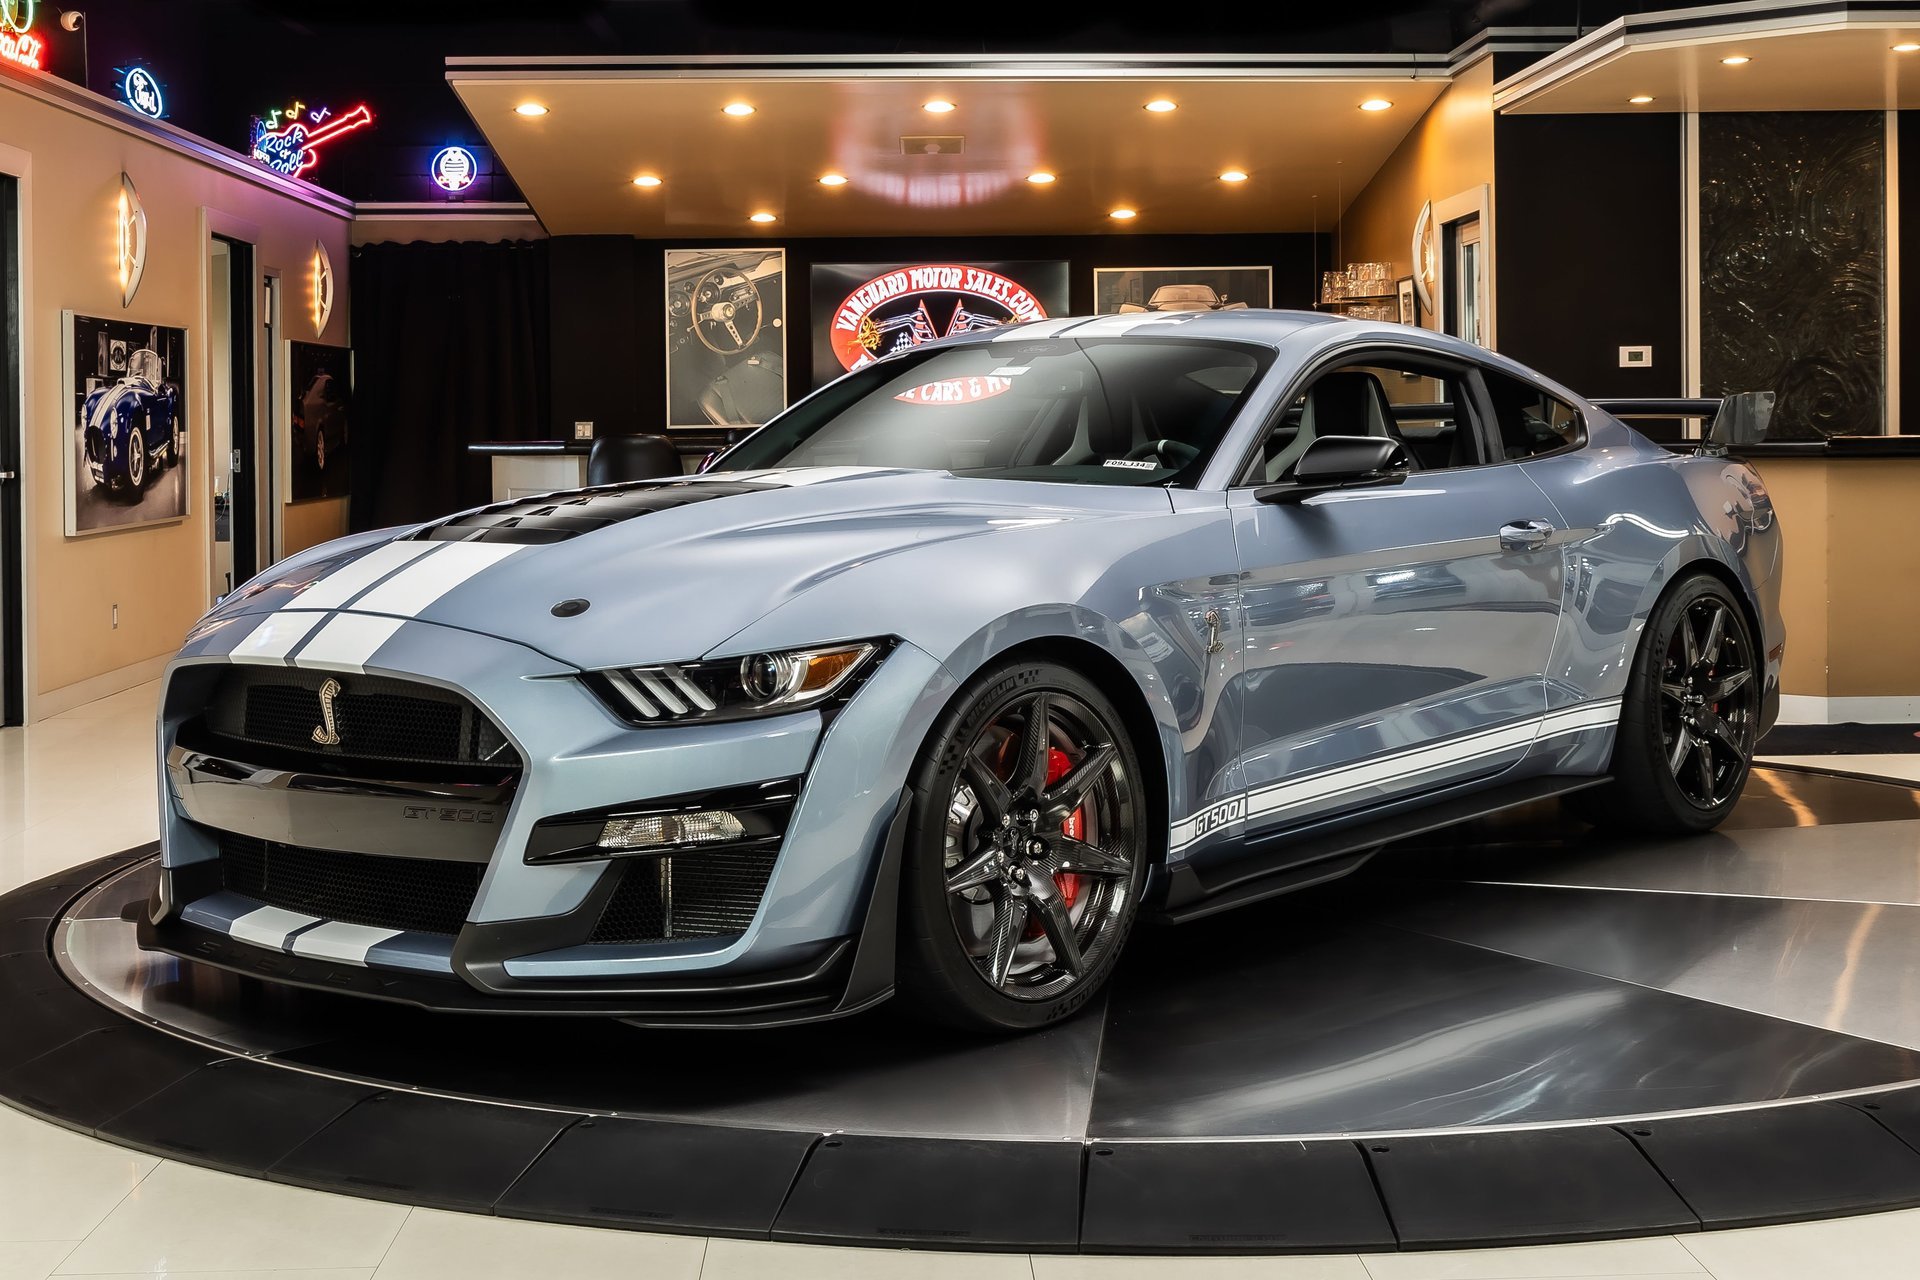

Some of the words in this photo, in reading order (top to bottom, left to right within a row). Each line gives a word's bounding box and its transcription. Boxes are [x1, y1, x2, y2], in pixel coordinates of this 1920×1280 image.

[265, 126, 304, 153] Rock
[835, 272, 908, 332] VANGUARD
[909, 266, 963, 290] MOTOR
[964, 268, 1043, 323] SALES.COM
[921, 381, 963, 401] CARS
[967, 377, 981, 398] &
[966, 676, 1016, 727] MICHELIN
[1197, 801, 1239, 835] GT500
